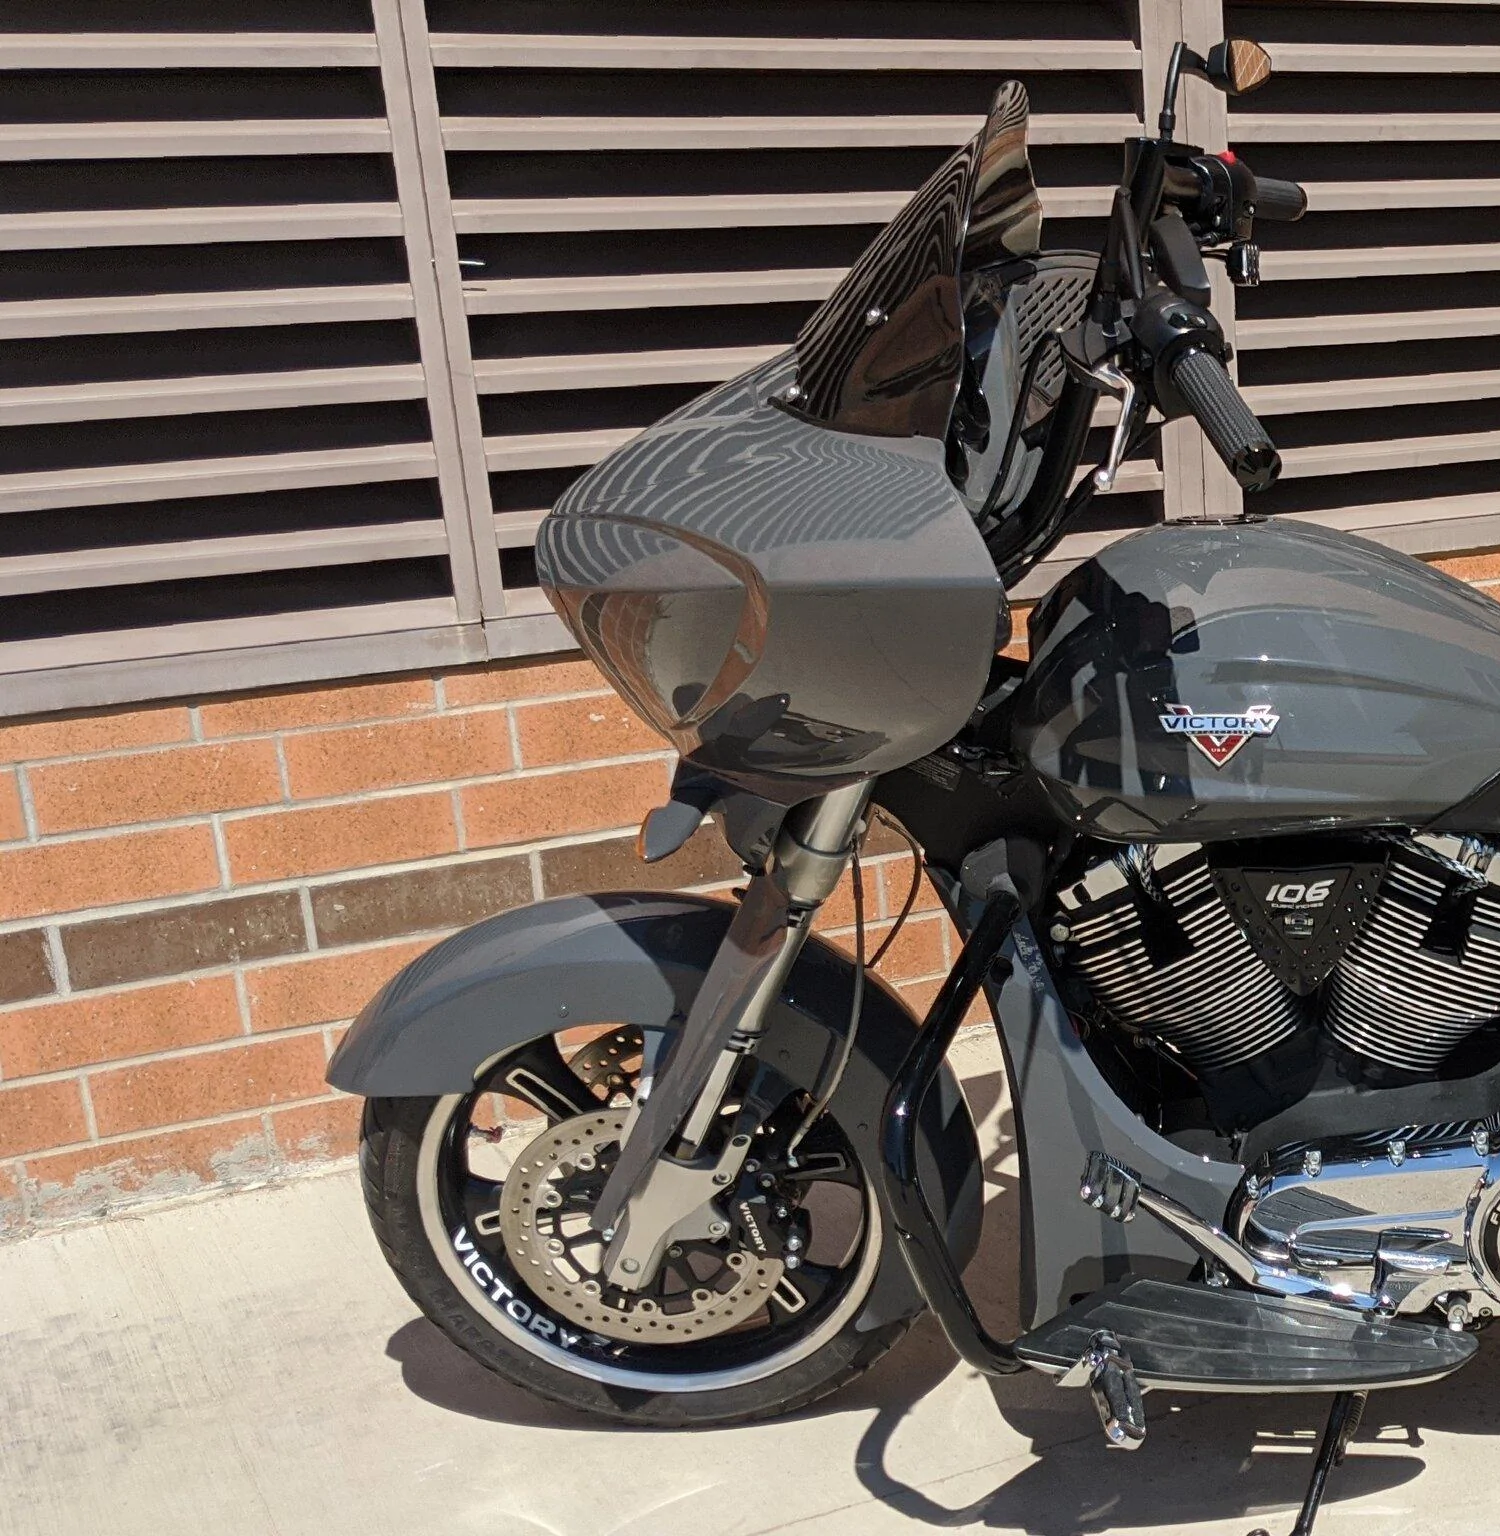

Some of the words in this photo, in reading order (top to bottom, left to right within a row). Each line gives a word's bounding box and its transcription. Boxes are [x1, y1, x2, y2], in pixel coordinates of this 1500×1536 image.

[1164, 716, 1275, 730] VICTORY
[1265, 878, 1336, 904] 106
[739, 1202, 767, 1252] VICTORY
[453, 1226, 582, 1348] VICTORY
